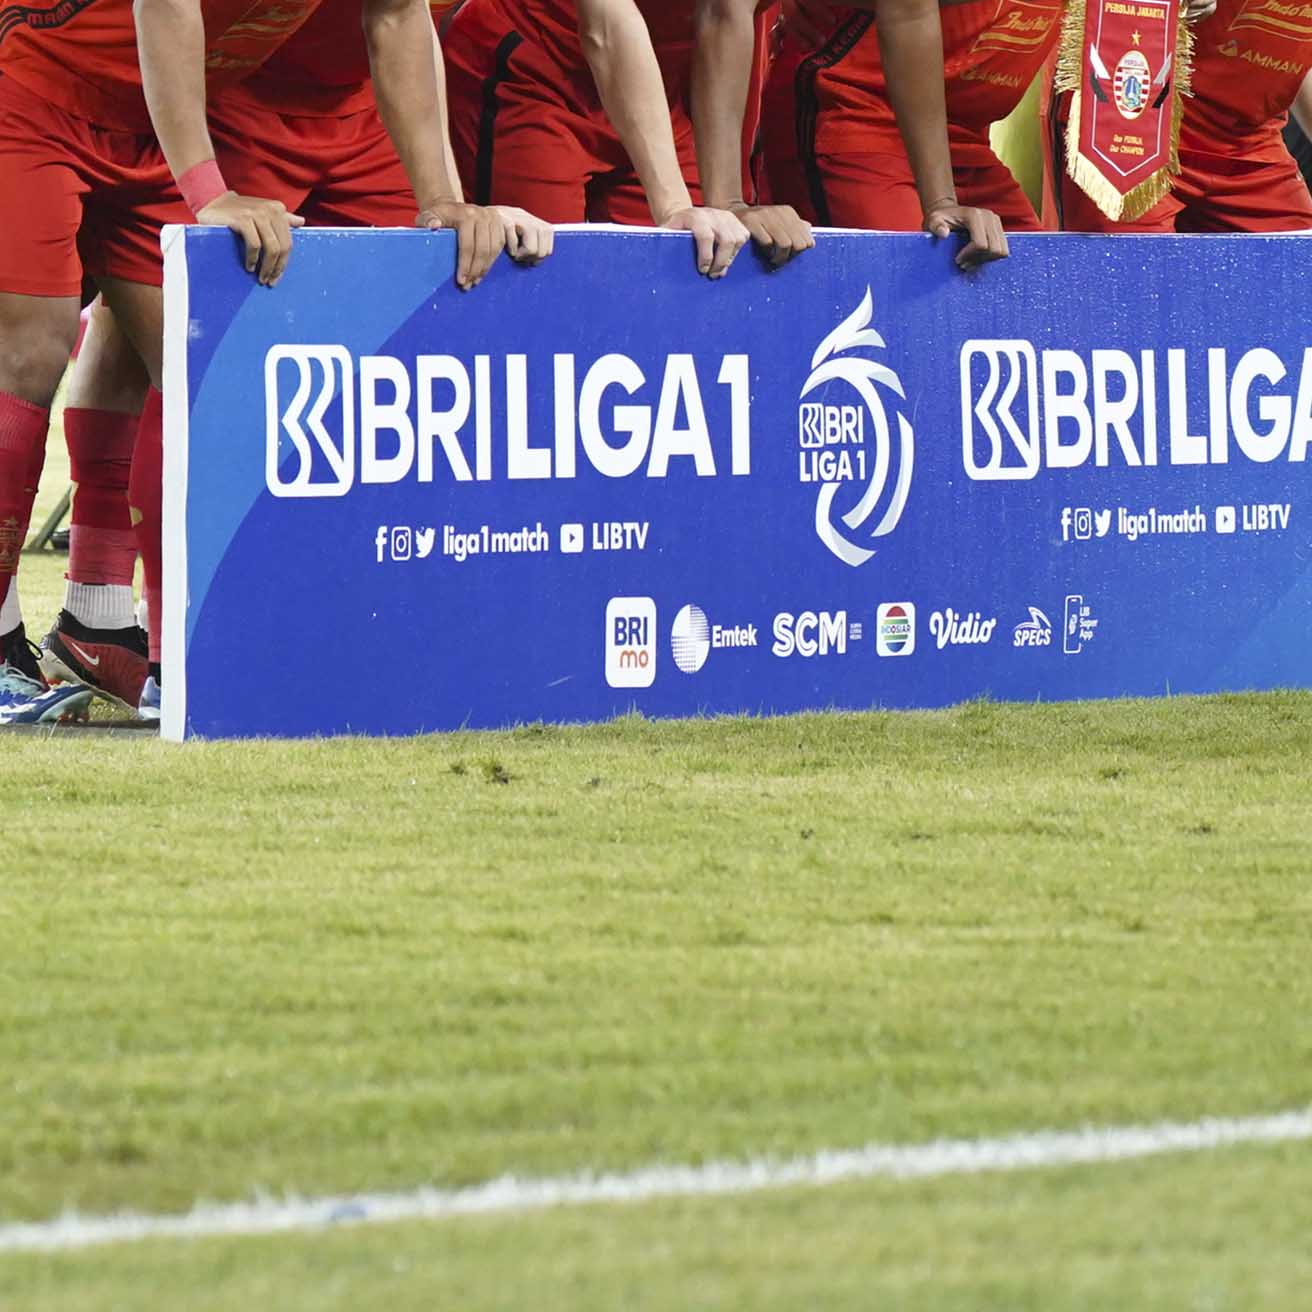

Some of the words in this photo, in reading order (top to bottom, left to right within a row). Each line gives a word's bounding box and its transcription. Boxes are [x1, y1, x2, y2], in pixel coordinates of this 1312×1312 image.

[1240, 49, 1303, 75] AMMAN
[825, 405, 864, 445] BRI
[1117, 509, 1207, 541] liga1match
[1242, 503, 1291, 531] LIBTV
[442, 522, 549, 562] liga1match
[591, 521, 650, 550] LIBTV
[614, 616, 648, 646] BRI
[712, 623, 758, 648] Emtek
[772, 610, 847, 657] SCM
[929, 607, 997, 650] Vidio
[1013, 628, 1052, 647] SPECS
[619, 649, 649, 669] mo
